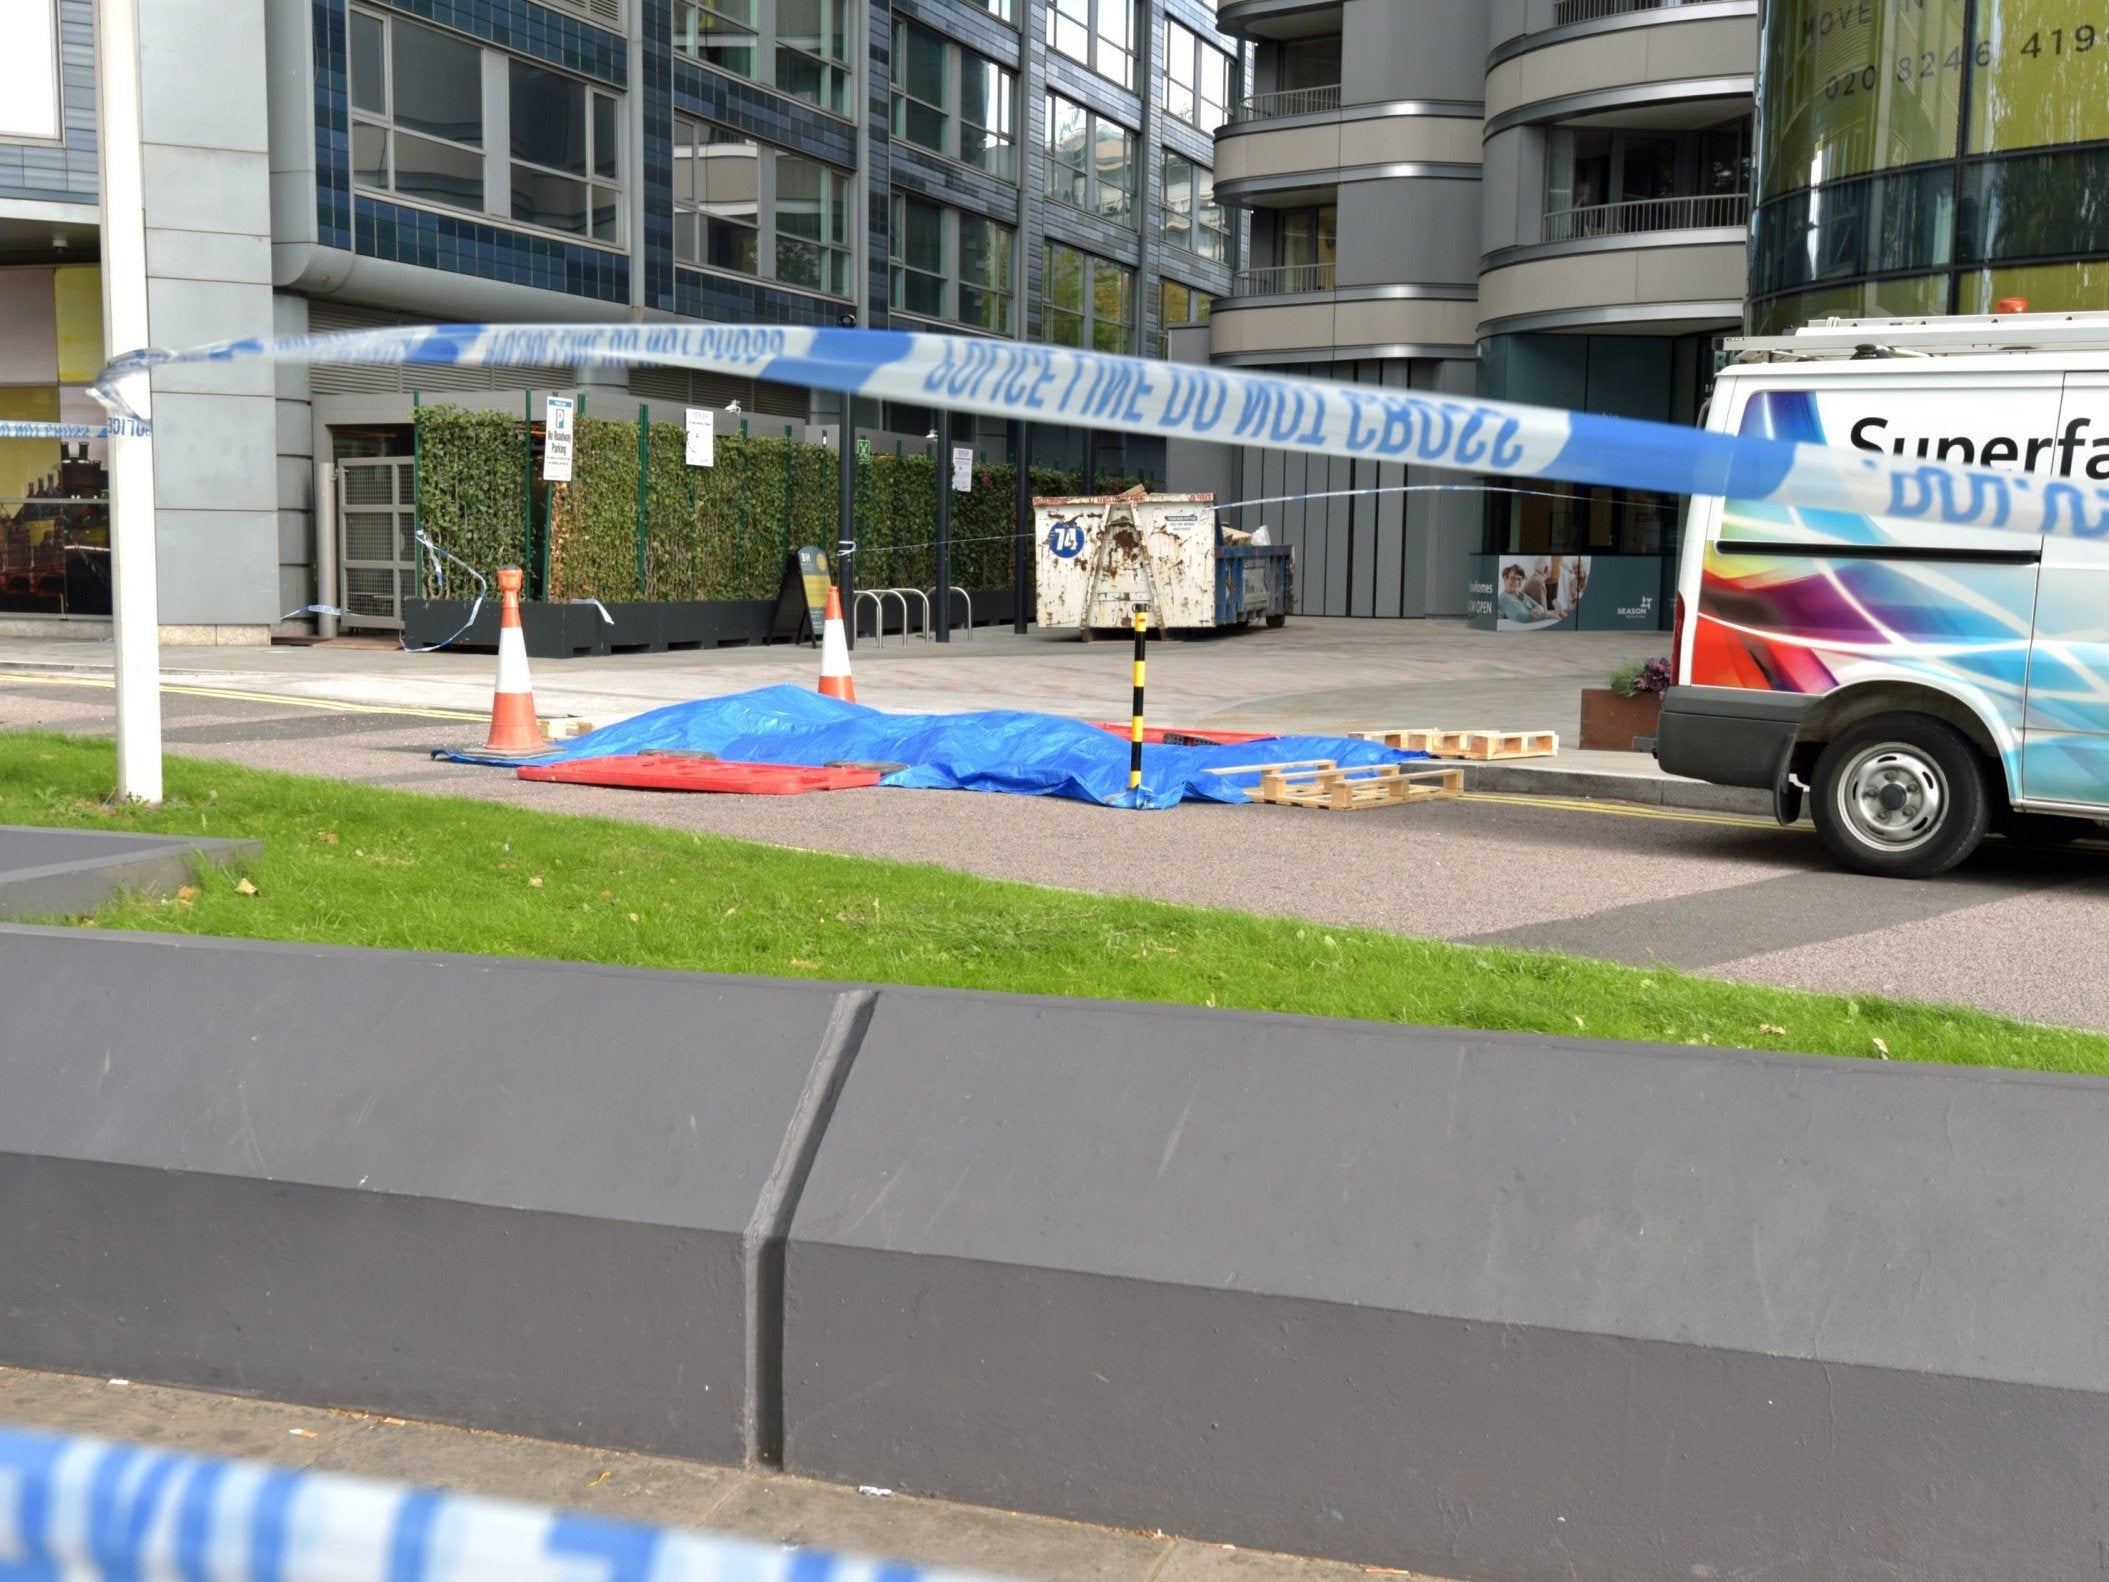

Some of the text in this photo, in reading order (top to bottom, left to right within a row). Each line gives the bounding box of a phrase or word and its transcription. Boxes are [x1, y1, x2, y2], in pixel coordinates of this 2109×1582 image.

[1802, 0, 1872, 45] MOVE
[1825, 24, 2109, 100] 020 8246 419
[552, 443, 567, 456] Parking
[1055, 528, 1077, 550] 74
[1476, 600, 1492, 614] OPEN
[1617, 607, 1647, 615] SEASON
